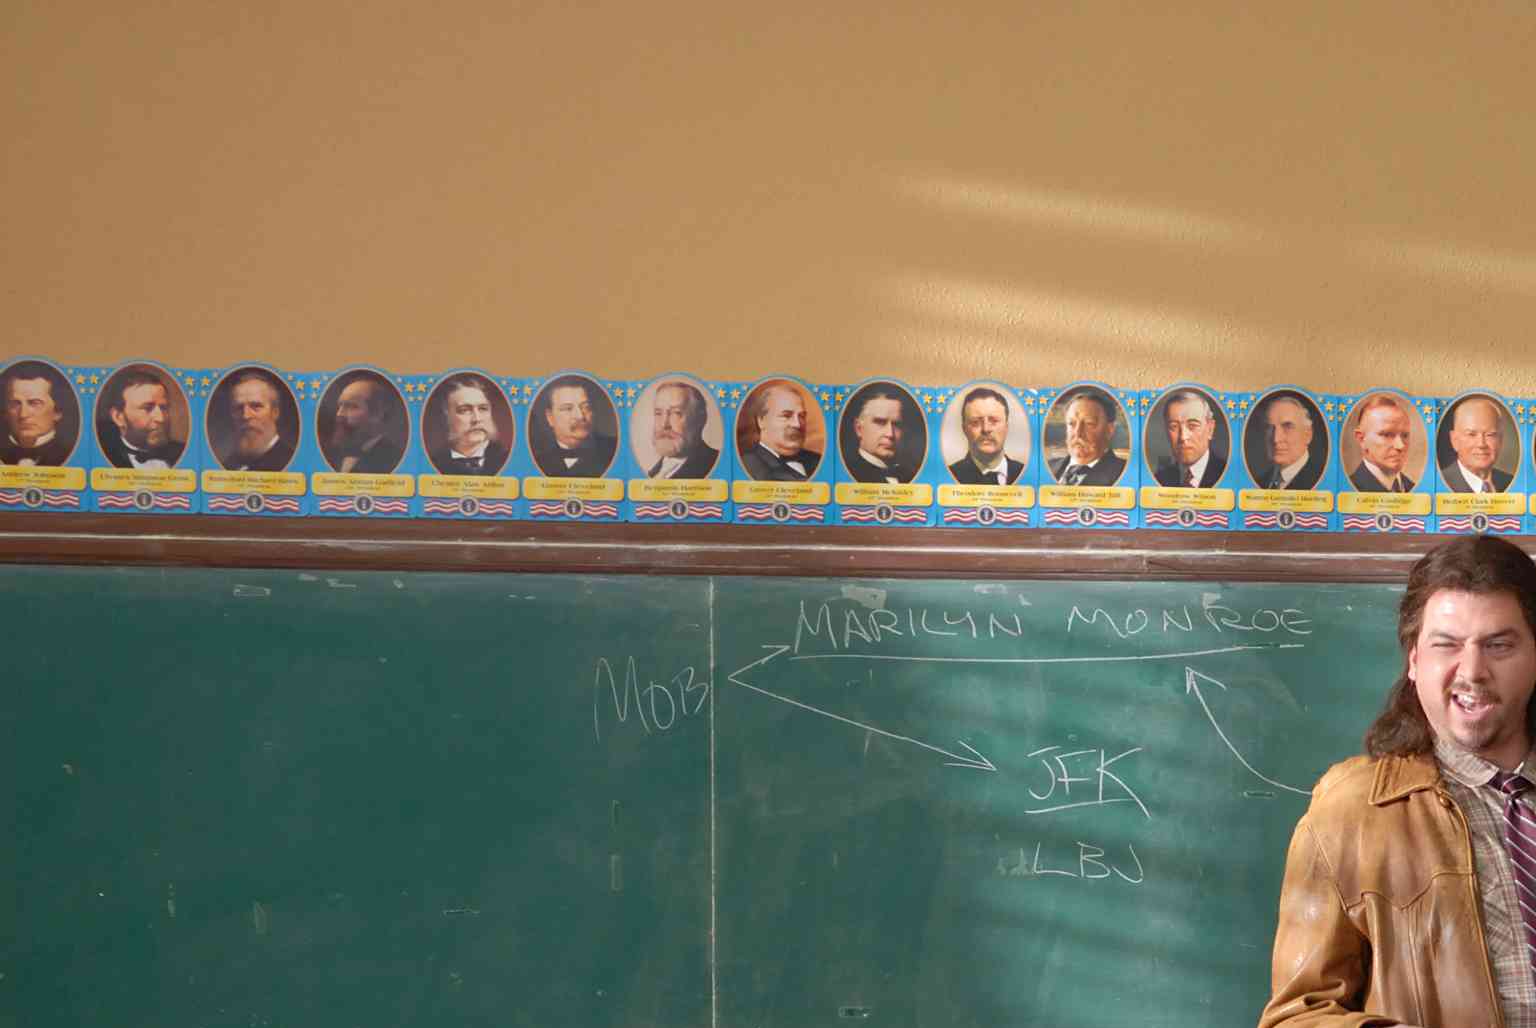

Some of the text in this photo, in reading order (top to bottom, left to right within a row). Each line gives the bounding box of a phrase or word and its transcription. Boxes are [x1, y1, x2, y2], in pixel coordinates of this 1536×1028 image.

[794, 600, 1313, 653] MARILYN MONROE
[593, 655, 709, 744] MOB
[1027, 746, 1152, 819] JFK
[1033, 842, 1143, 883] LBJ
